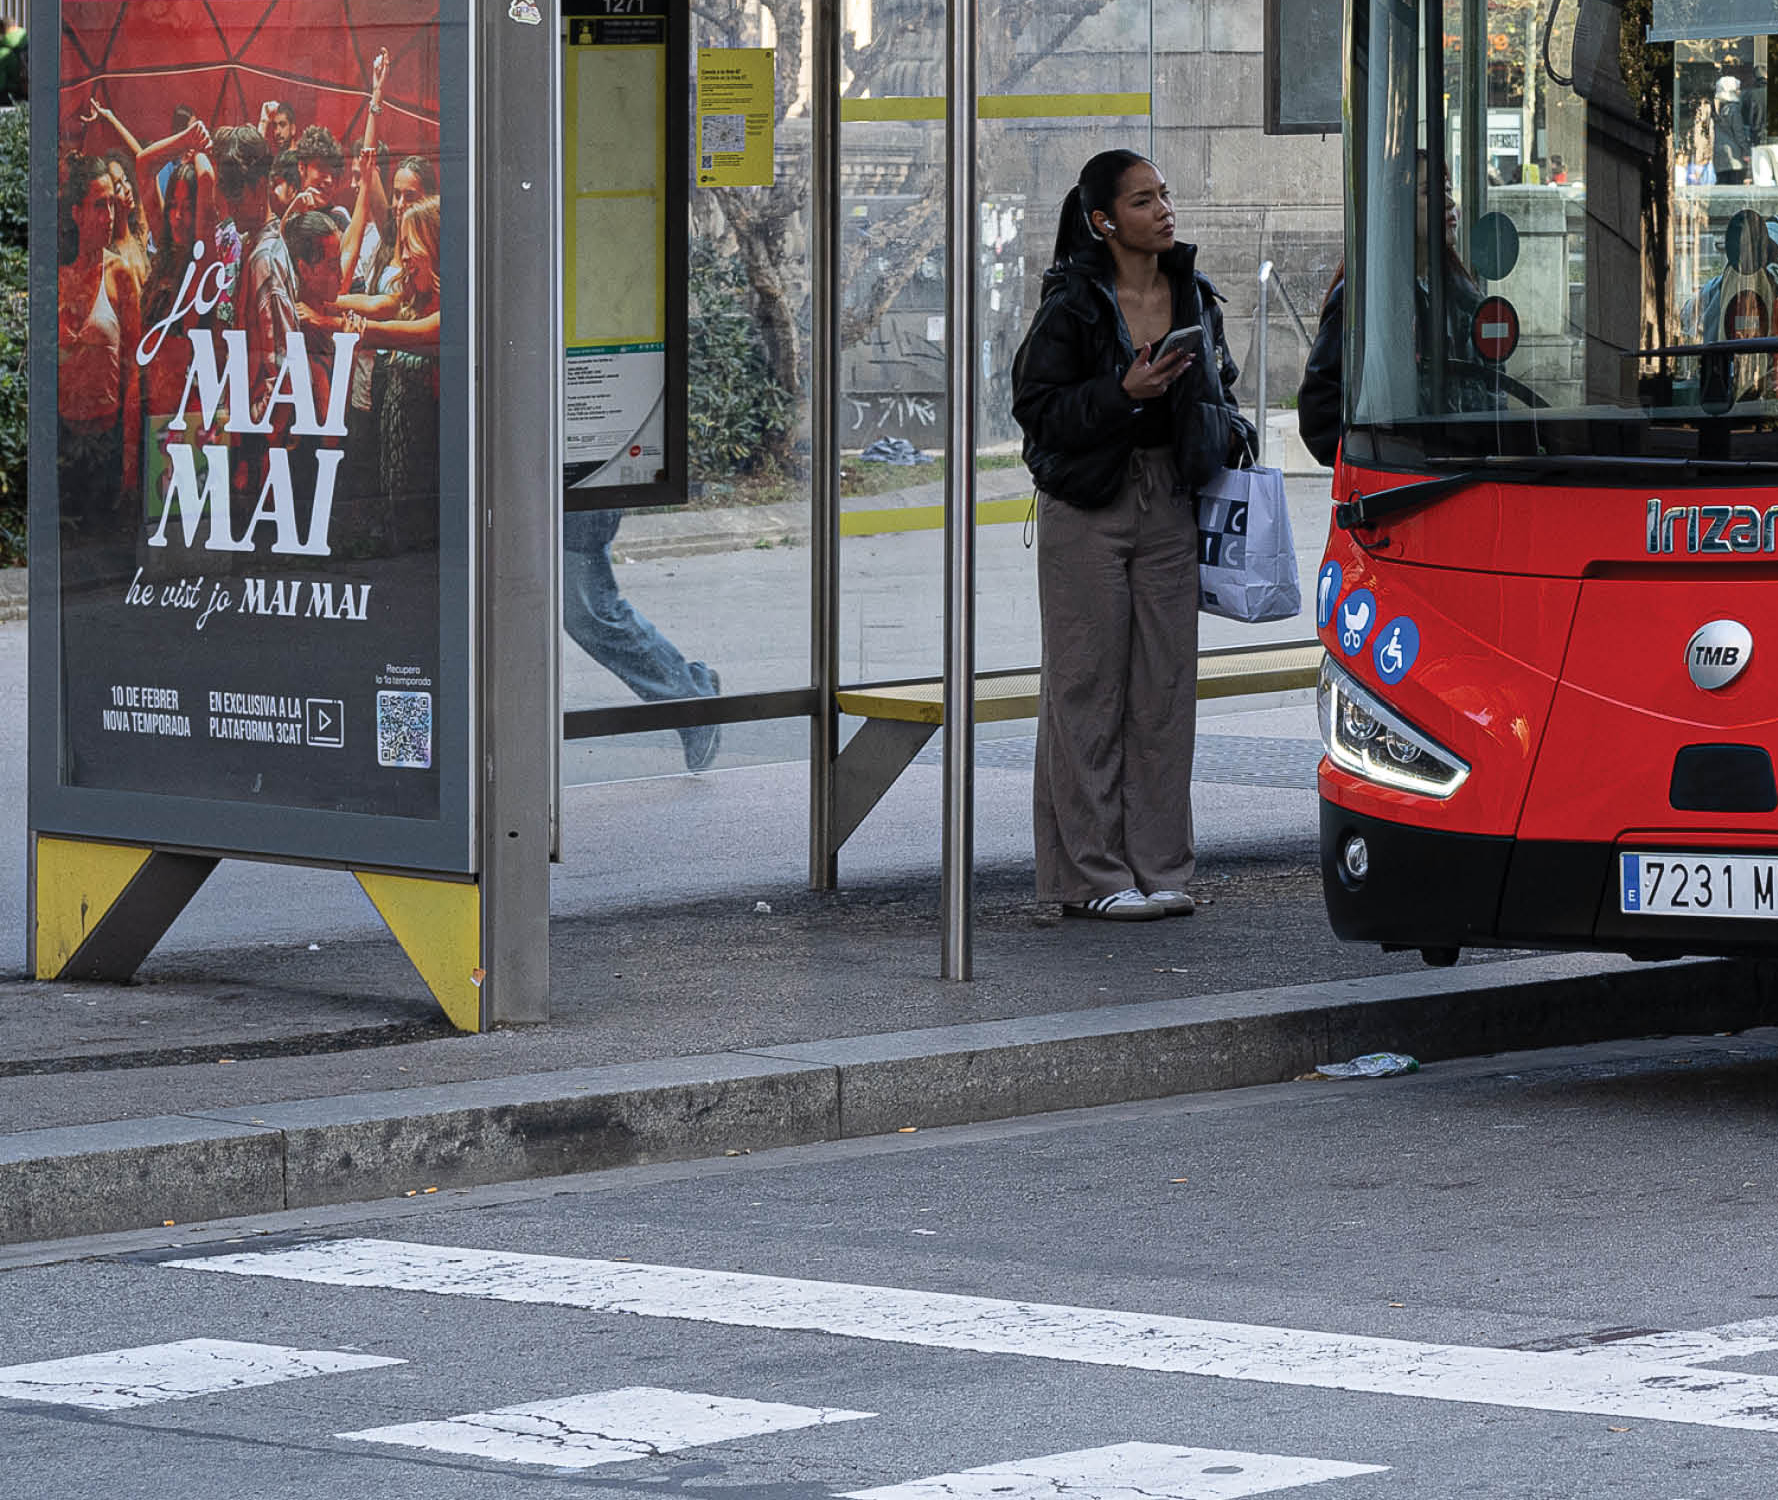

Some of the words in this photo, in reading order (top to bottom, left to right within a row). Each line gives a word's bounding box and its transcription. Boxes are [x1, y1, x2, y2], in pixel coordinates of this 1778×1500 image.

[136, 240, 236, 366] jo
[167, 328, 360, 436] MAI
[147, 443, 345, 556] MAI
[125, 566, 155, 605] he
[160, 576, 204, 609] vist
[196, 582, 232, 631] jo
[238, 577, 302, 617] MAI
[304, 582, 372, 620] MAI
[386, 663, 421, 675] Recupera
[1694, 645, 1740, 668] TMB
[393, 677, 432, 687] temporada
[111, 685, 124, 706] 10
[126, 686, 140, 708] DE
[141, 687, 179, 711] FEBRER
[209, 691, 223, 713] EN
[224, 691, 276, 717] EXCLUSIVA
[278, 698, 286, 717] A
[287, 698, 302, 719] LA
[102, 709, 129, 733] NOVA
[131, 712, 192, 738] TEMPORADA
[209, 717, 274, 743] PLATAFORMA
[275, 721, 302, 745] 3CAT
[1627, 888, 1638, 903] E
[1645, 861, 1735, 909] 7231
